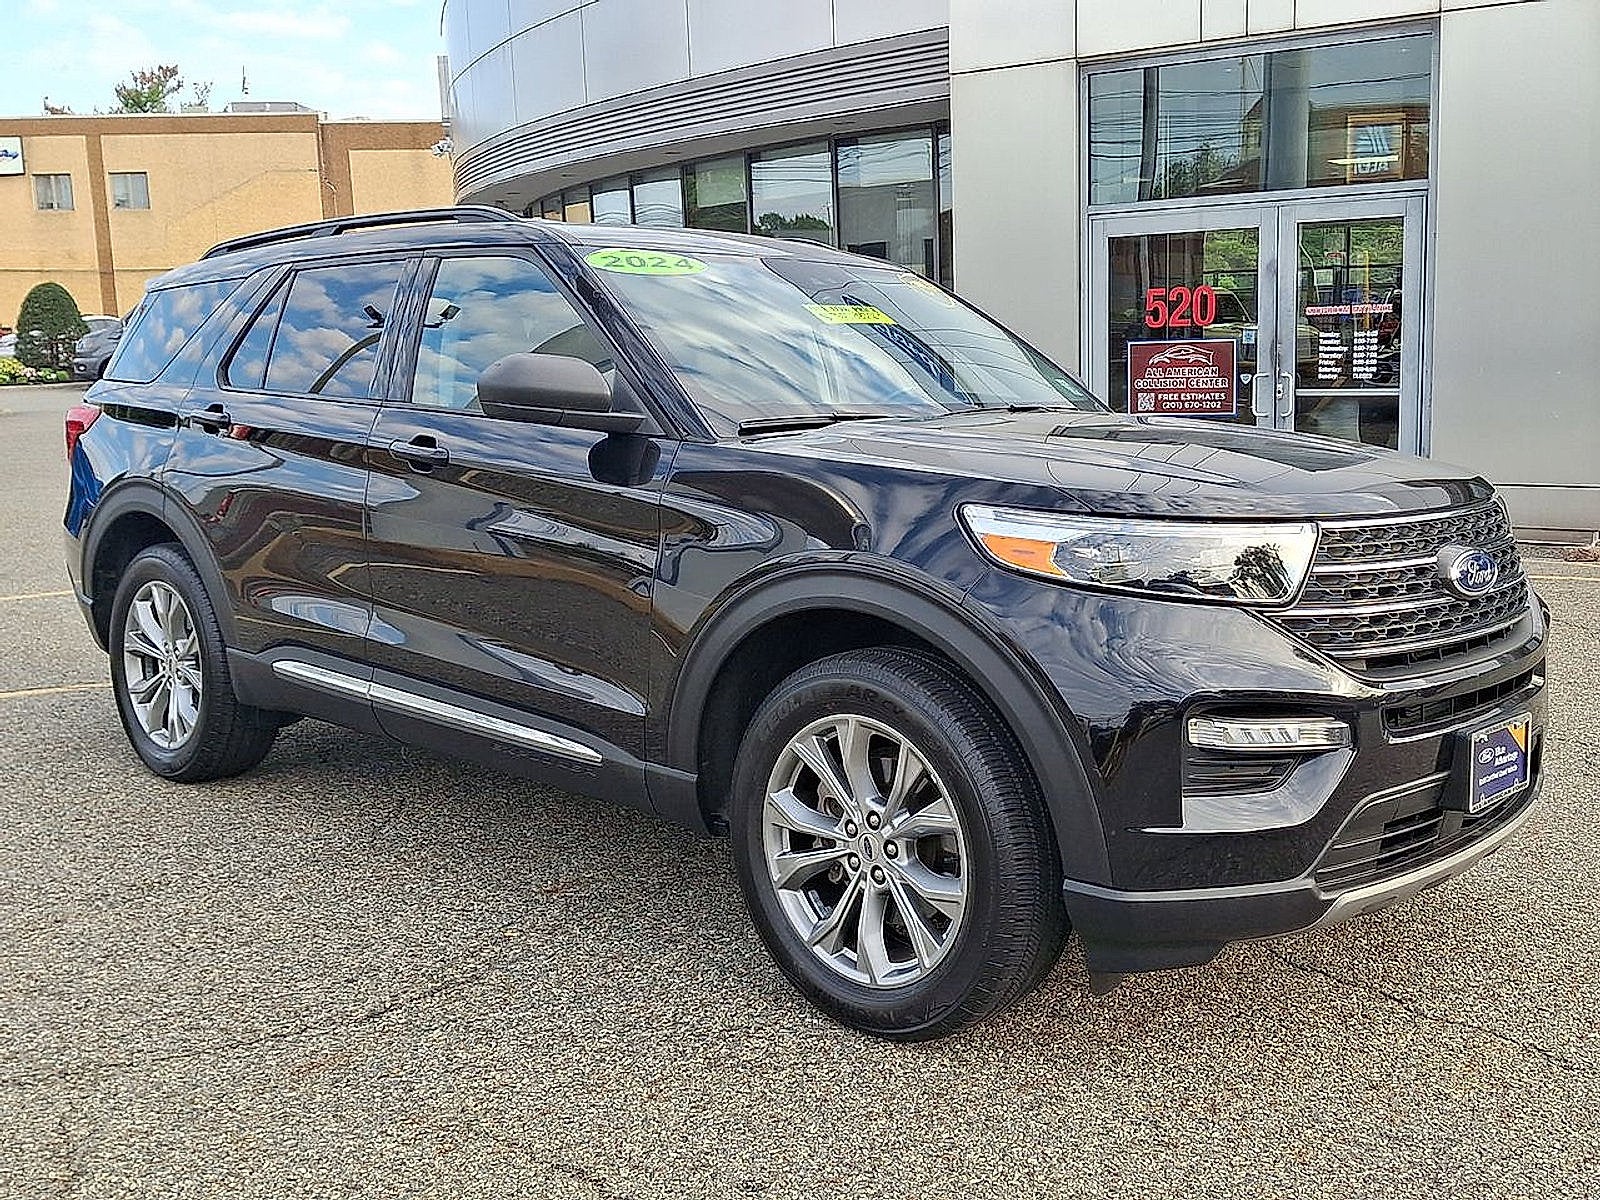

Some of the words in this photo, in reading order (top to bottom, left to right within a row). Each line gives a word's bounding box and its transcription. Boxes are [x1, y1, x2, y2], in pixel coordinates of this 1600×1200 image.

[601, 255, 693, 270] 2024
[1145, 286, 1216, 328] 520
[1145, 368, 1164, 378] ALL
[1165, 366, 1219, 378] AMERICAN
[1134, 379, 1186, 389] COLLISION
[1188, 377, 1229, 389] CENTER
[1162, 401, 1183, 409] (201)
[1184, 401, 1222, 409] 670-1202
[1461, 560, 1492, 586] Ford
